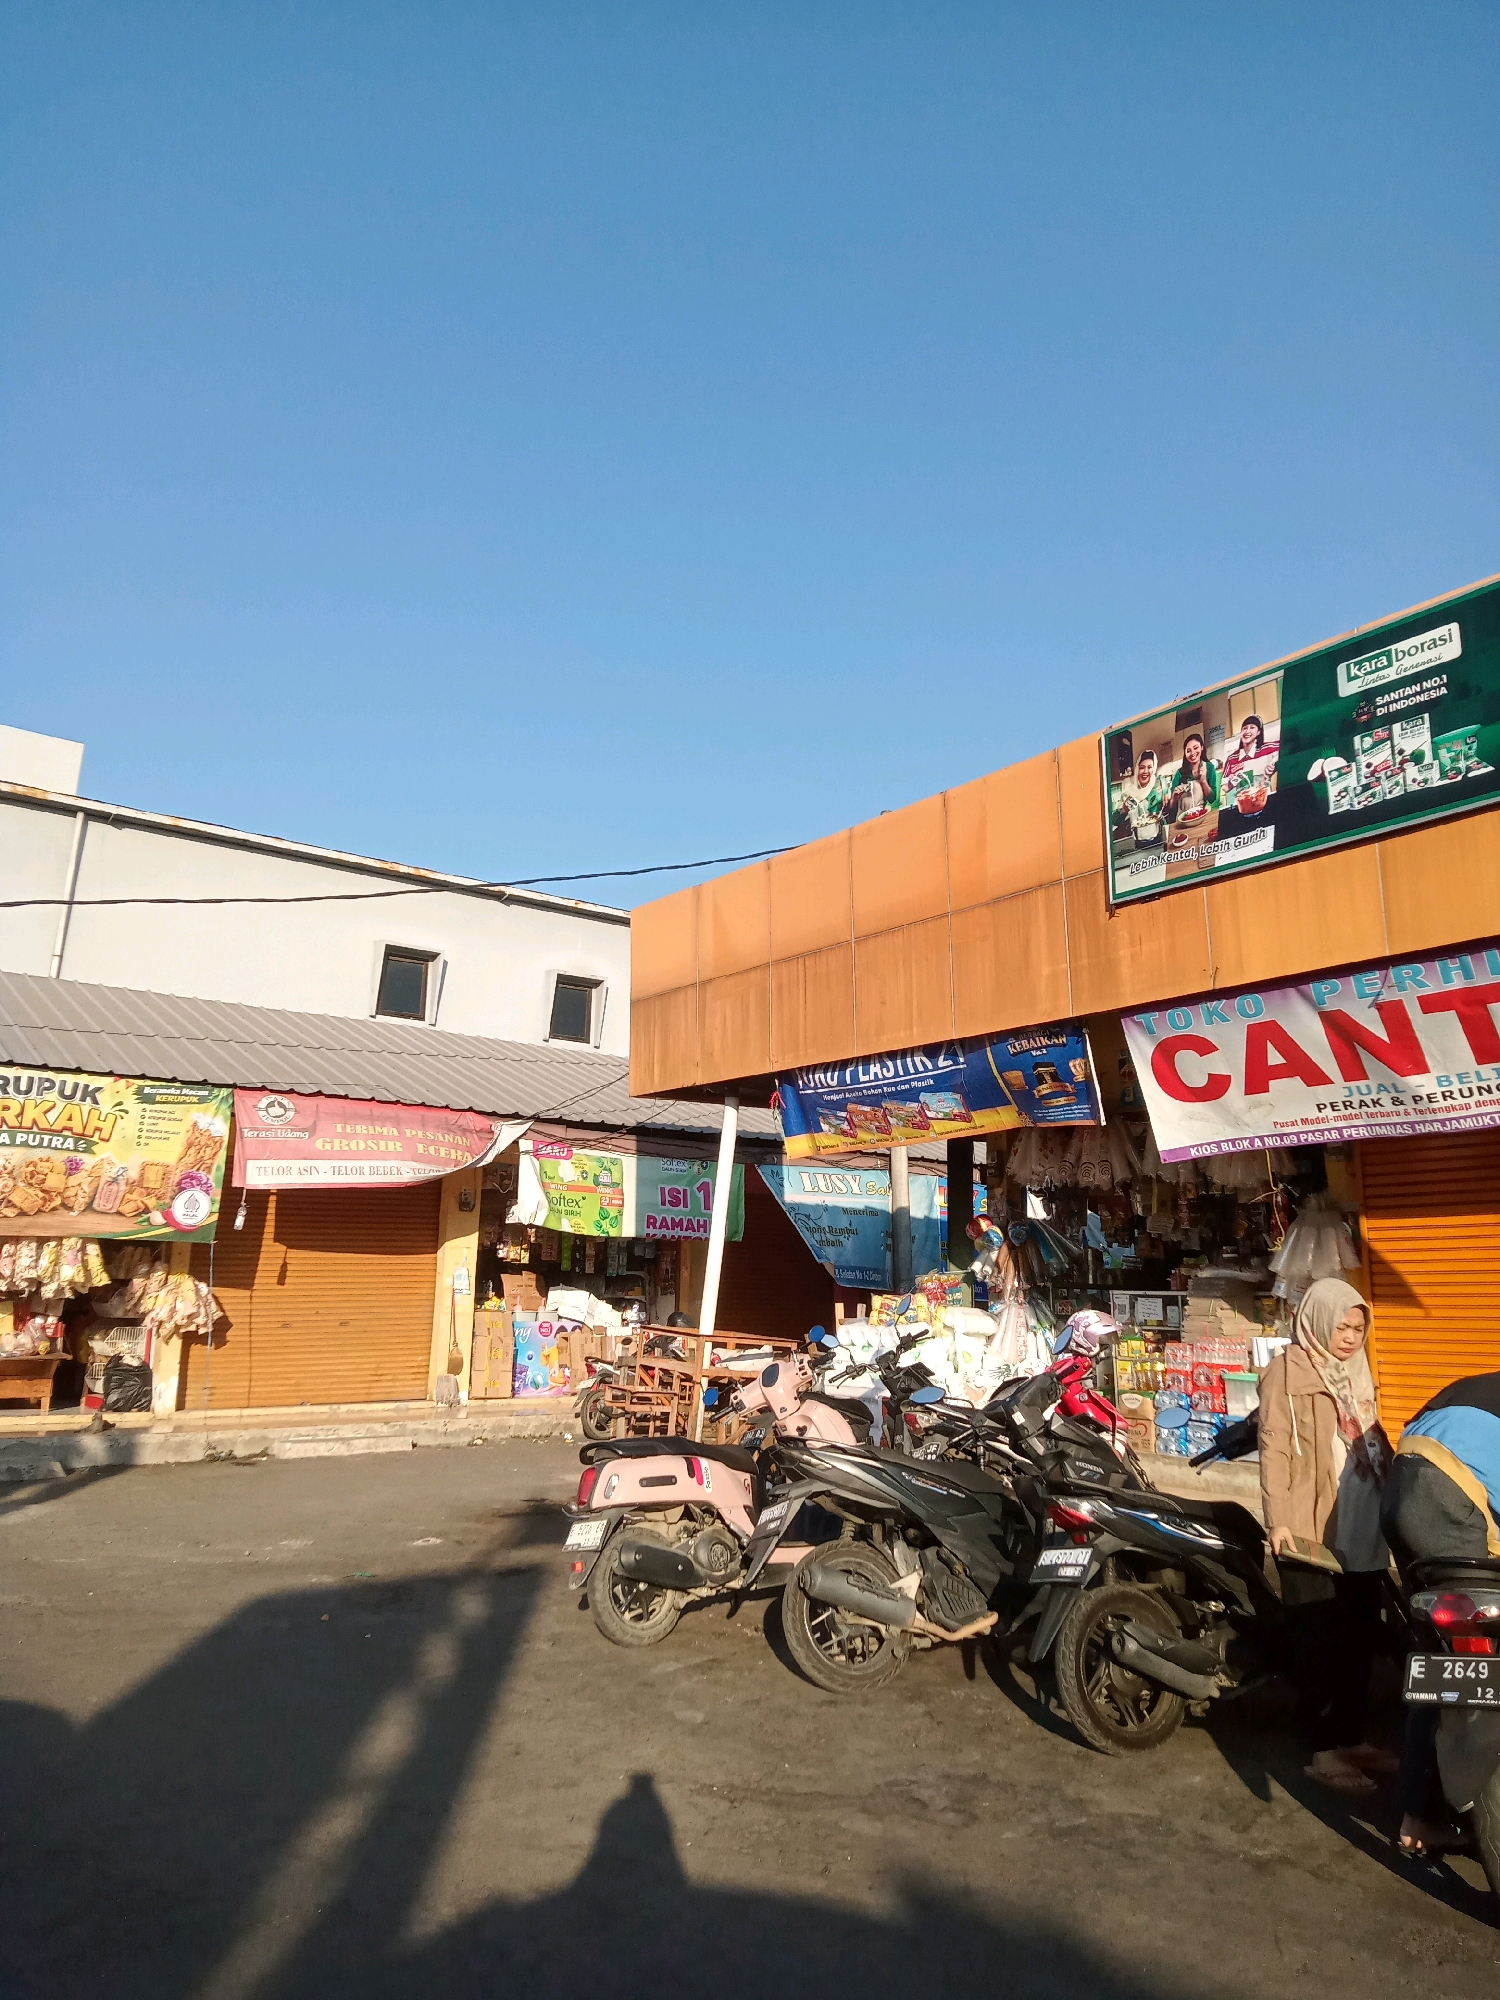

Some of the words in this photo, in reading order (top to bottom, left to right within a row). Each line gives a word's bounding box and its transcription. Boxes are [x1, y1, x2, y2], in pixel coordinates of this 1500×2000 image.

[1350, 654, 1388, 677] kara
[1394, 628, 1454, 662] borasi
[1357, 671, 1391, 688] Lintas
[1395, 652, 1444, 675] Generasi
[1375, 682, 1421, 706] SANTAN
[1421, 674, 1448, 691] NO.1
[1376, 706, 1388, 717] DI
[1389, 687, 1449, 713] INDONESIA
[1403, 718, 1423, 729] kara
[1130, 856, 1159, 877] Lebih
[1159, 846, 1198, 864] Kental,
[1200, 840, 1232, 856] Lebih
[1234, 827, 1267, 848] Gurih
[1135, 993, 1266, 1036] TOKO
[1007, 1034, 1067, 1055] KEBAIKAN
[155, 1094, 199, 1103] KERUPUK
[1342, 1082, 1407, 1098] JUAL
[1315, 1097, 1386, 1114] PERAK
[1391, 1096, 1406, 1107] &
[1273, 1118, 1299, 1129] Pusat
[1300, 1112, 1363, 1126] Model-model
[1365, 1108, 1401, 1119] Terbaru
[1403, 1108, 1412, 1117] &
[1413, 1101, 1472, 1117] Terlengkap
[15, 1133, 75, 1150] PUTRA
[241, 1128, 276, 1138] Terasi
[277, 1128, 310, 1140] Udang
[334, 1123, 400, 1137] TERIMA
[404, 1128, 471, 1148] PESANAN
[1189, 1144, 1219, 1157] KIOS
[1220, 1138, 1251, 1152] BLOK
[1254, 1135, 1263, 1148] A
[1265, 1133, 1298, 1147] NO.09
[1300, 1130, 1340, 1143] PASAR
[1343, 1122, 1412, 1138] PERUMNAS
[315, 1137, 404, 1153] GROSIR
[256, 1166, 293, 1177] TELOR
[298, 1166, 321, 1176] ASIN
[330, 1165, 366, 1176] TELOR
[368, 1165, 404, 1176] BEBEK
[550, 1183, 568, 1191] WING
[596, 1186, 614, 1195] WING
[799, 1172, 863, 1195] LUSY
[660, 1186, 690, 1209] ISI
[696, 1180, 712, 1211] 1
[841, 1207, 880, 1217] Menerima
[646, 1214, 709, 1234] RAMAH
[1075, 1460, 1105, 1475] HONDA
[1411, 1661, 1426, 1679] E
[1442, 1661, 1489, 1679] 2649
[1411, 1692, 1438, 1700] YAMAHA
